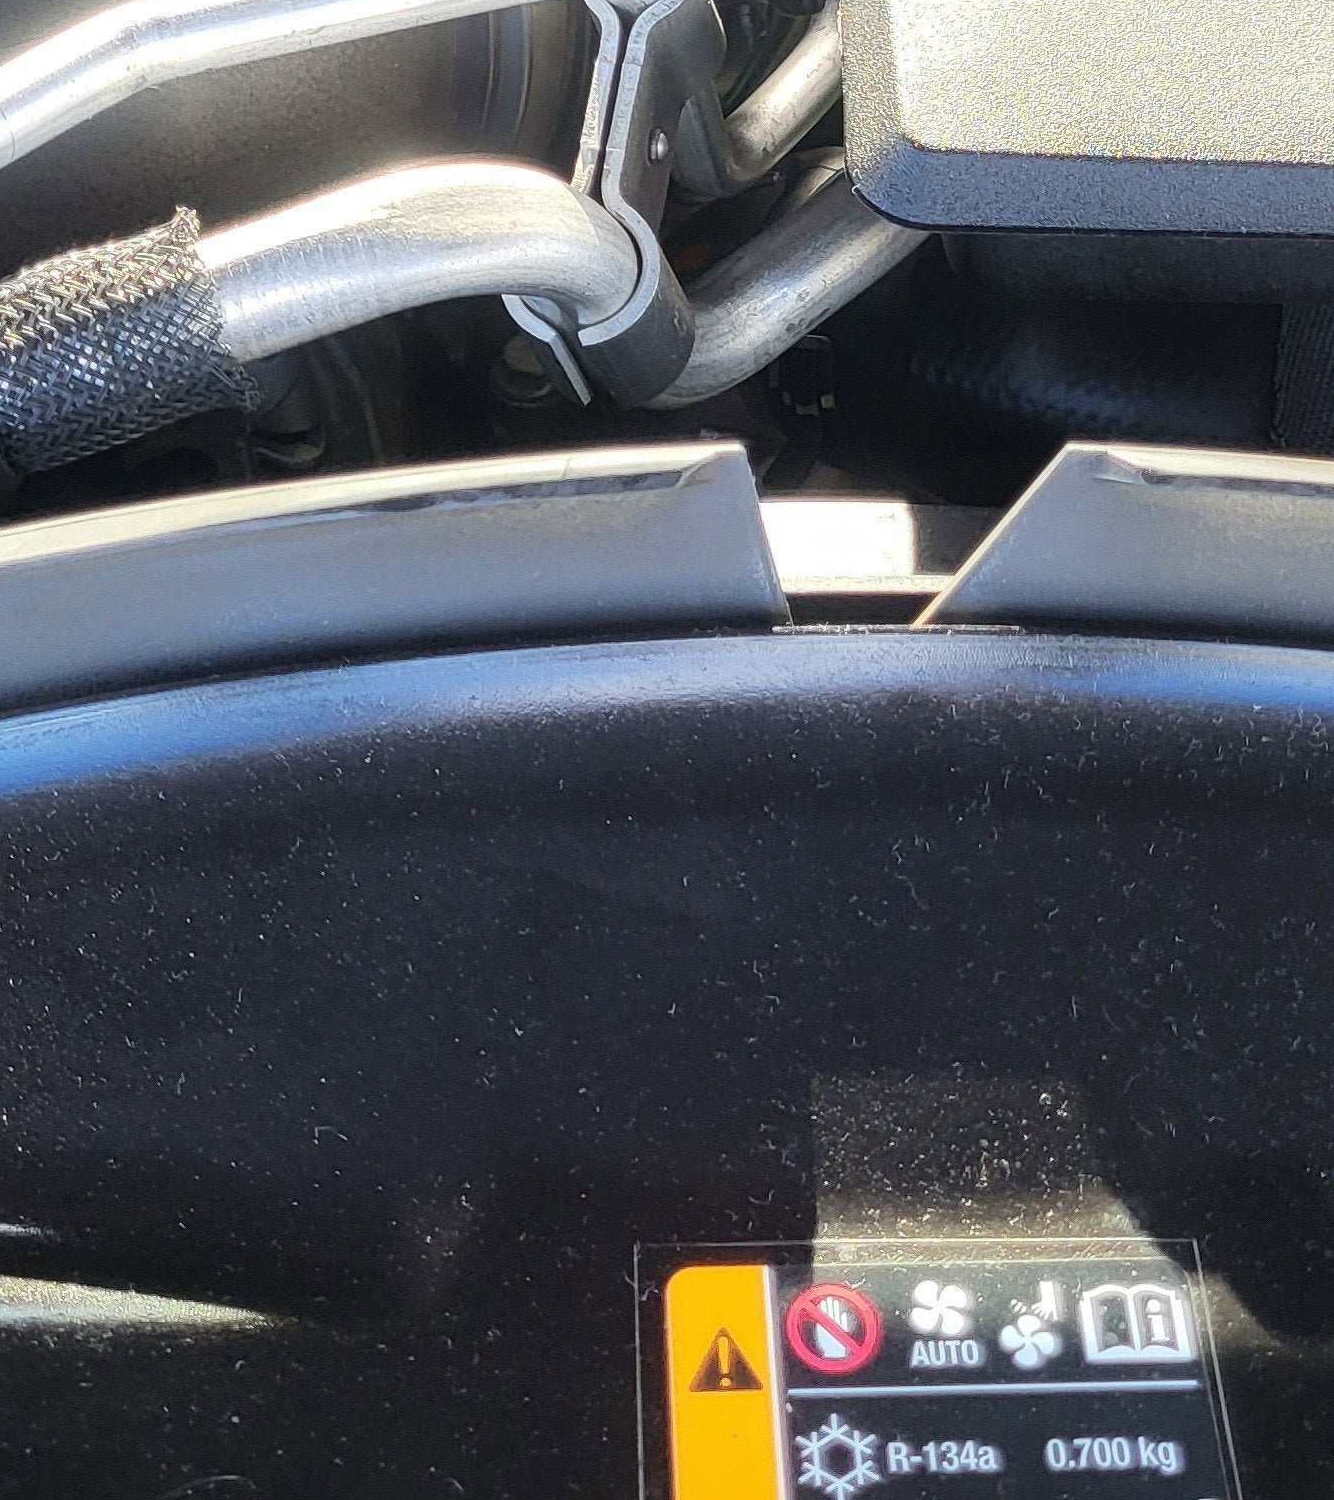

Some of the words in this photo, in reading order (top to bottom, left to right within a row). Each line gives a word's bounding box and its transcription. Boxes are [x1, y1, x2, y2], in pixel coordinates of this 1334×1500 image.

[910, 1340, 981, 1369] AUTO
[886, 1438, 999, 1474] R-134a
[1046, 1436, 1132, 1471] 0.700
[1137, 1435, 1179, 1473] kg
